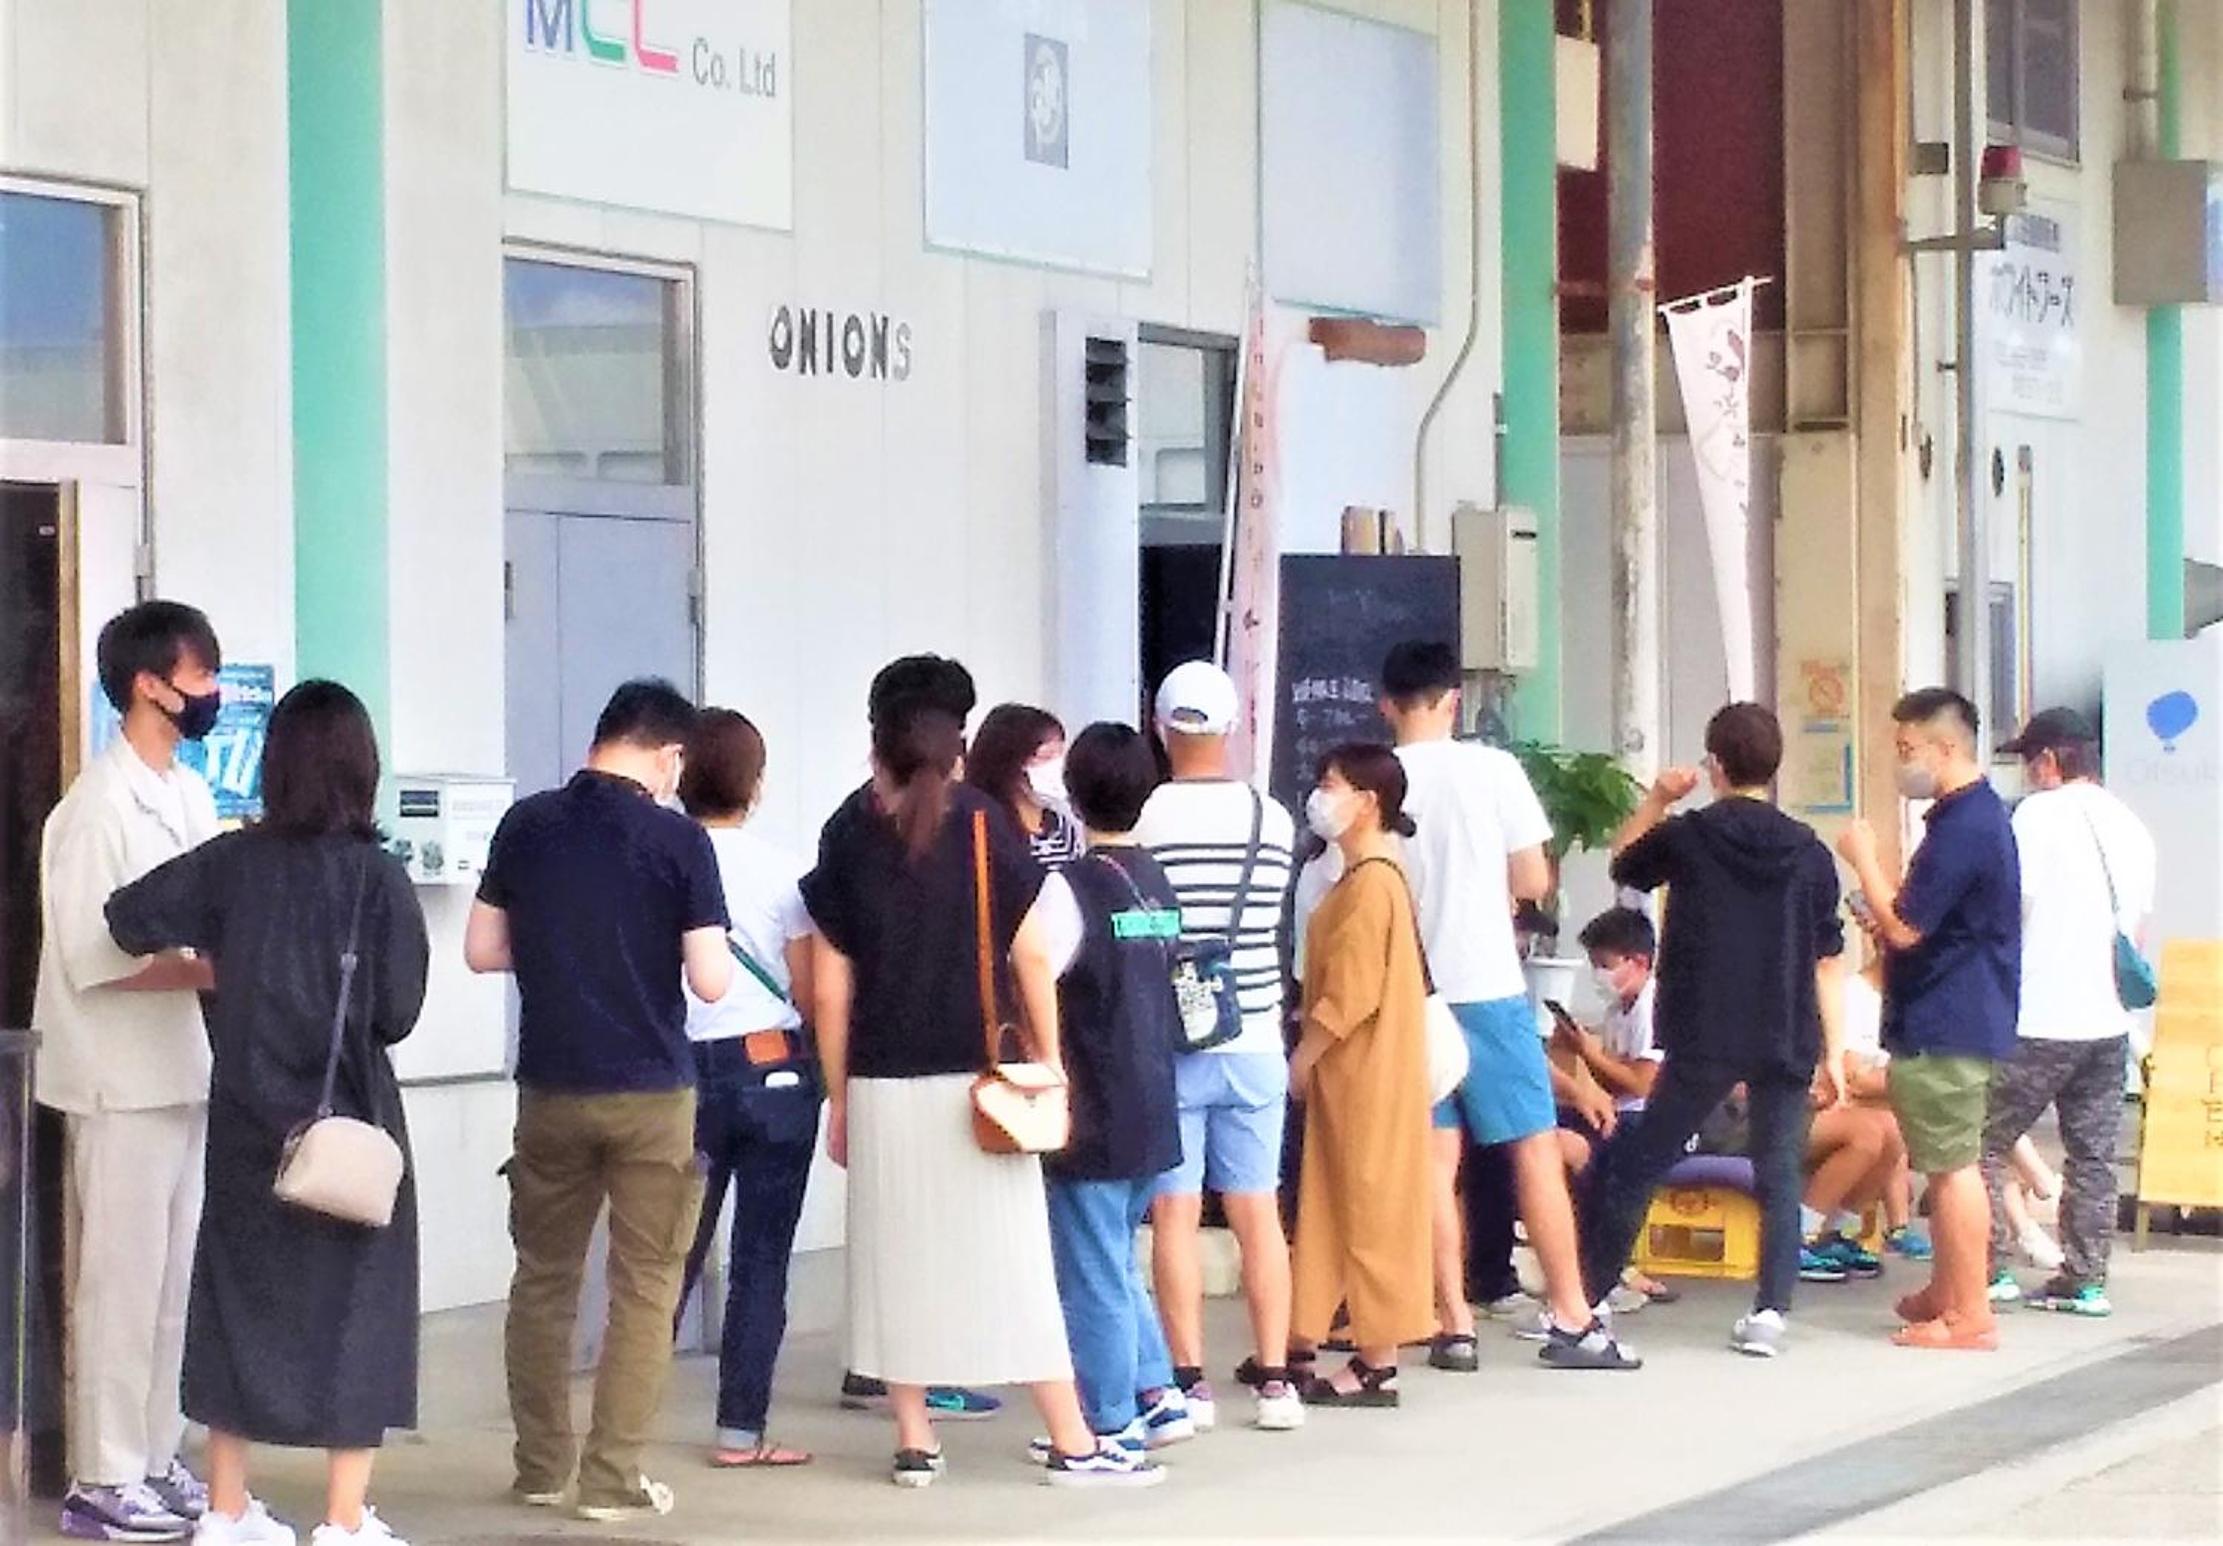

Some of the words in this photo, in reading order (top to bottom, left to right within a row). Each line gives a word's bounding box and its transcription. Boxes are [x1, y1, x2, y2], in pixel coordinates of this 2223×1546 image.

[692, 37, 731, 88] Co.
[740, 47, 776, 98] Ltd
[771, 304, 911, 381] ONIONS
